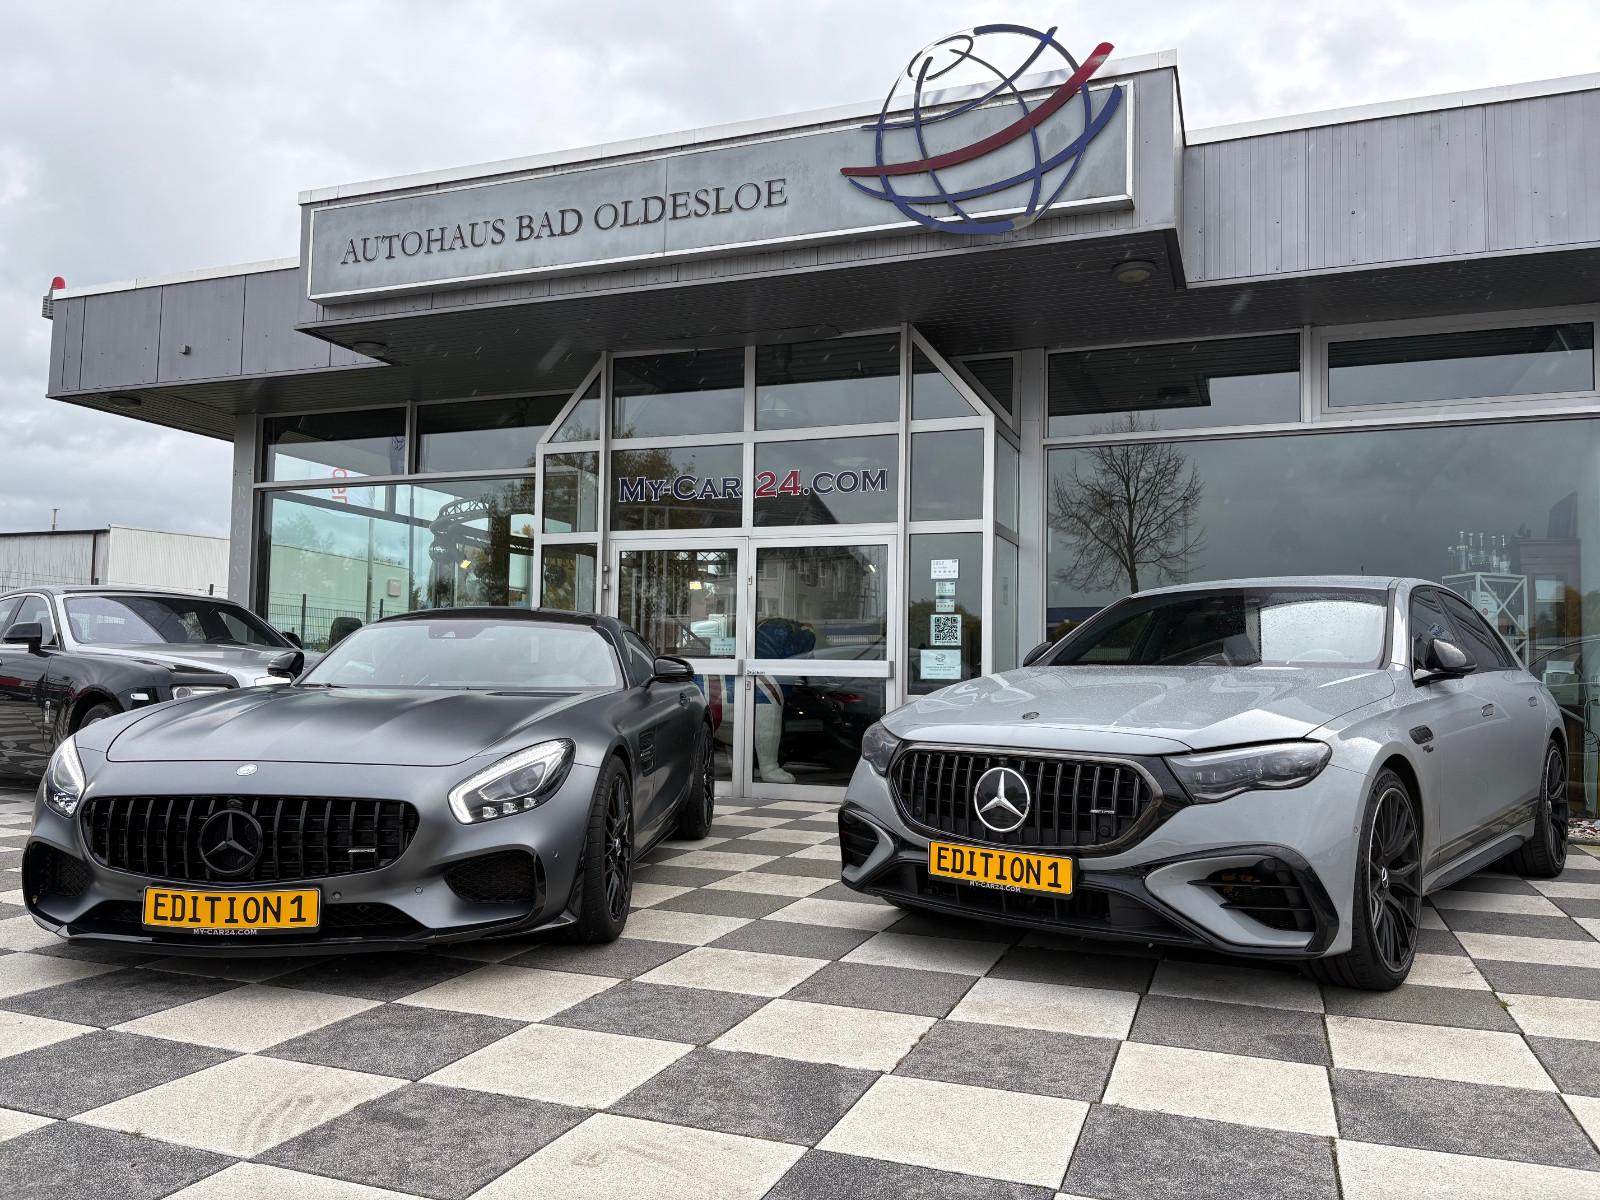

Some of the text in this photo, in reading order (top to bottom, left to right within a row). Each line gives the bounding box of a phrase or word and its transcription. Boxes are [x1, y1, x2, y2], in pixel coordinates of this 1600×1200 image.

[340, 178, 788, 265] AUTOHAUS BAD OLDESLOE
[193, 928, 257, 936] MY-CAR24.COM
